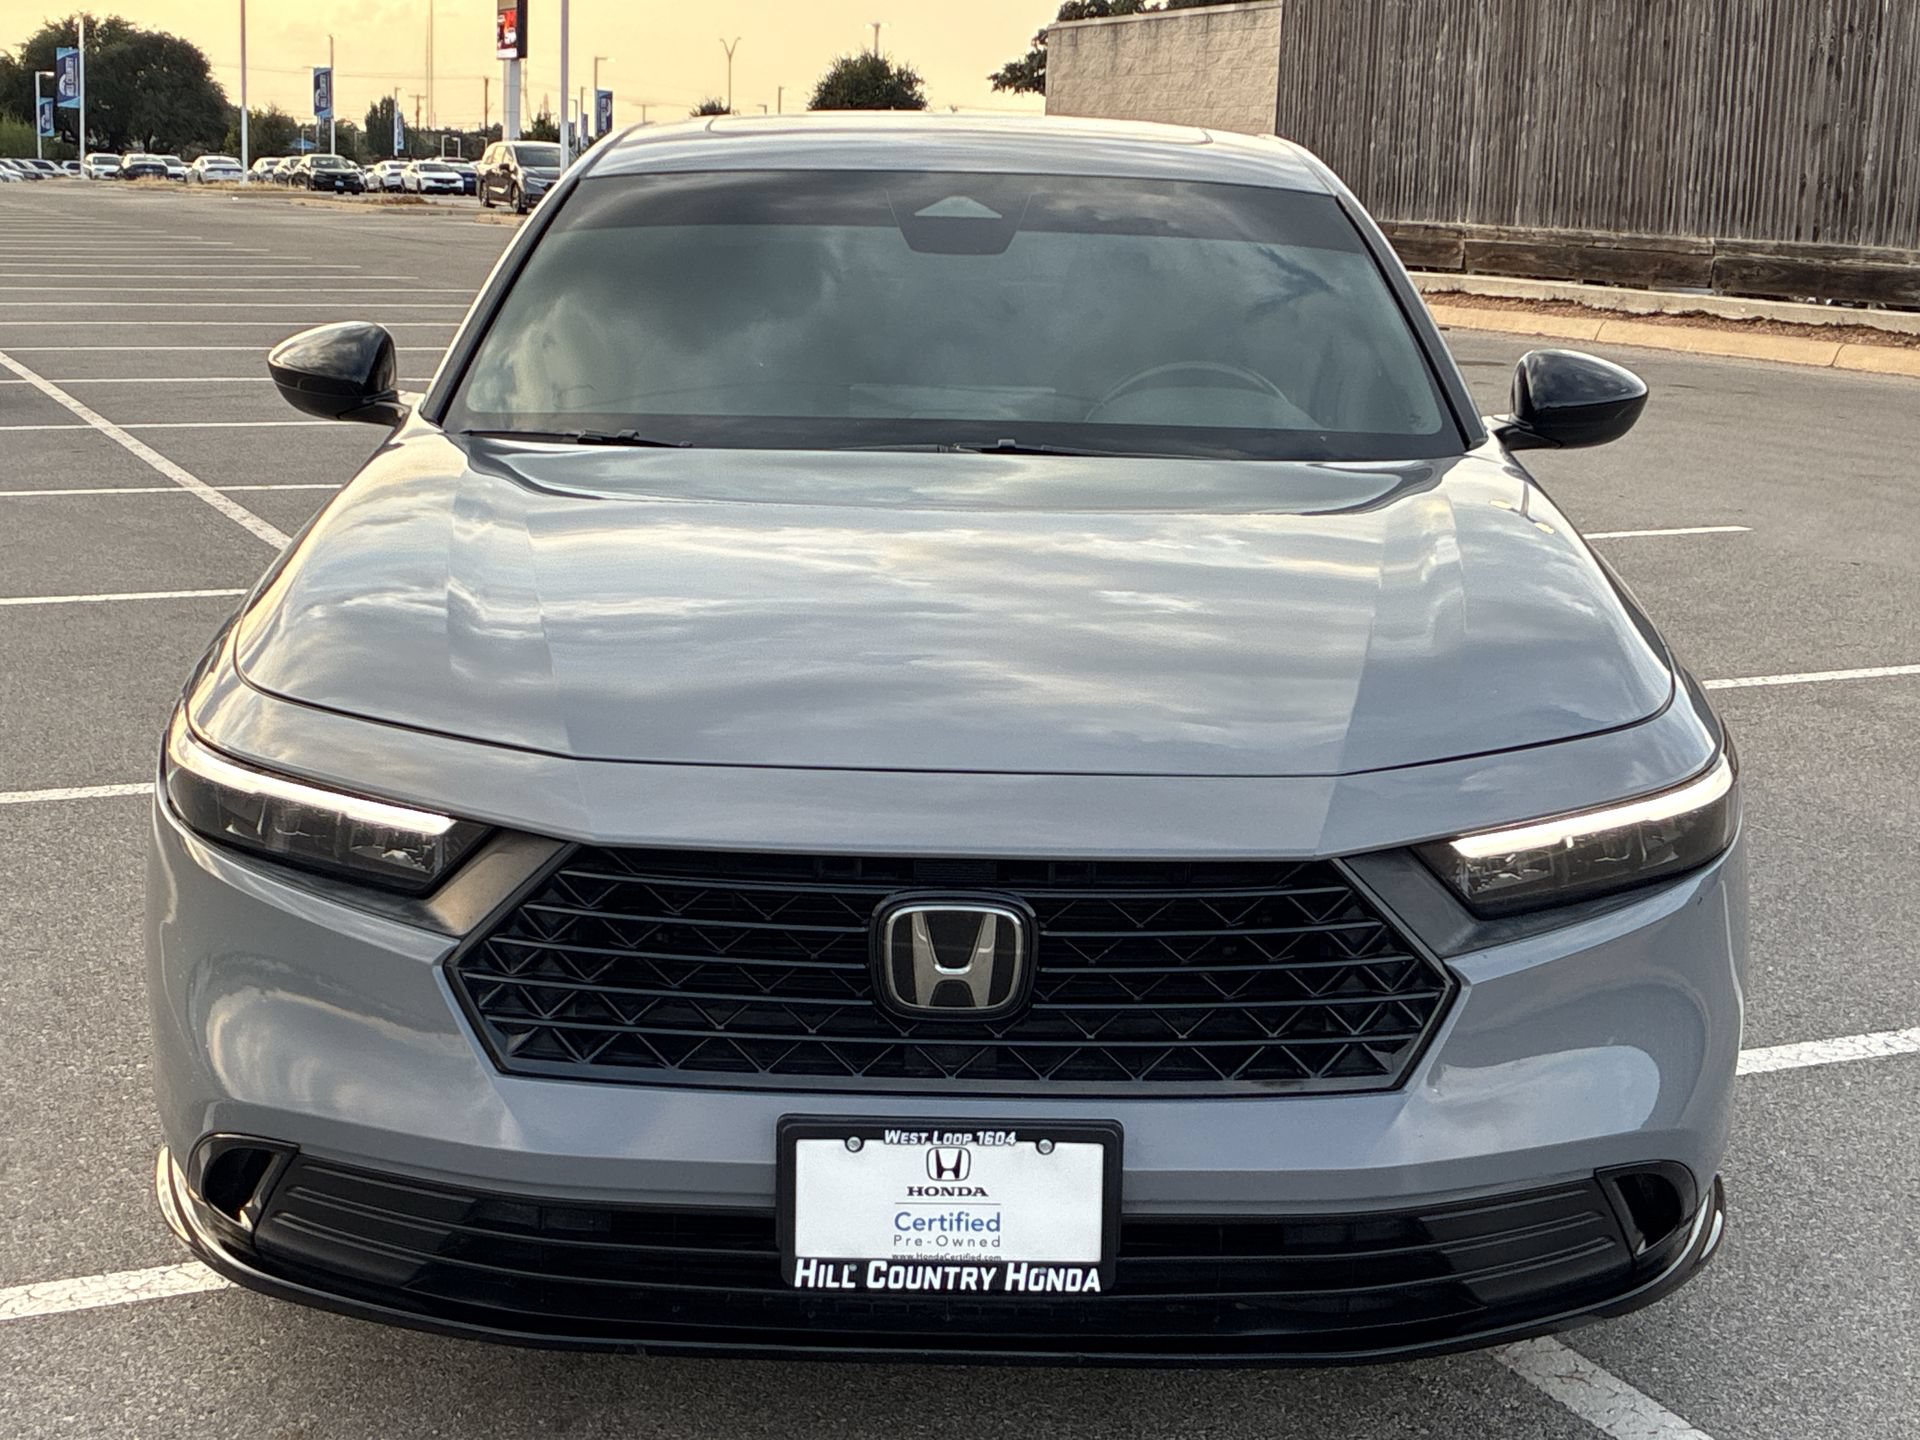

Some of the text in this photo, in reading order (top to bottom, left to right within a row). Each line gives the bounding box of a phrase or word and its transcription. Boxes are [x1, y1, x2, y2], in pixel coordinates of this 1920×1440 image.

[976, 1131, 1017, 1146] 1604
[907, 1186, 989, 1197] HONDA
[894, 1211, 1001, 1232] Certified
[893, 1234, 1001, 1248] Pre-Owned
[892, 1252, 1002, 1261] www.HondaCertified.com
